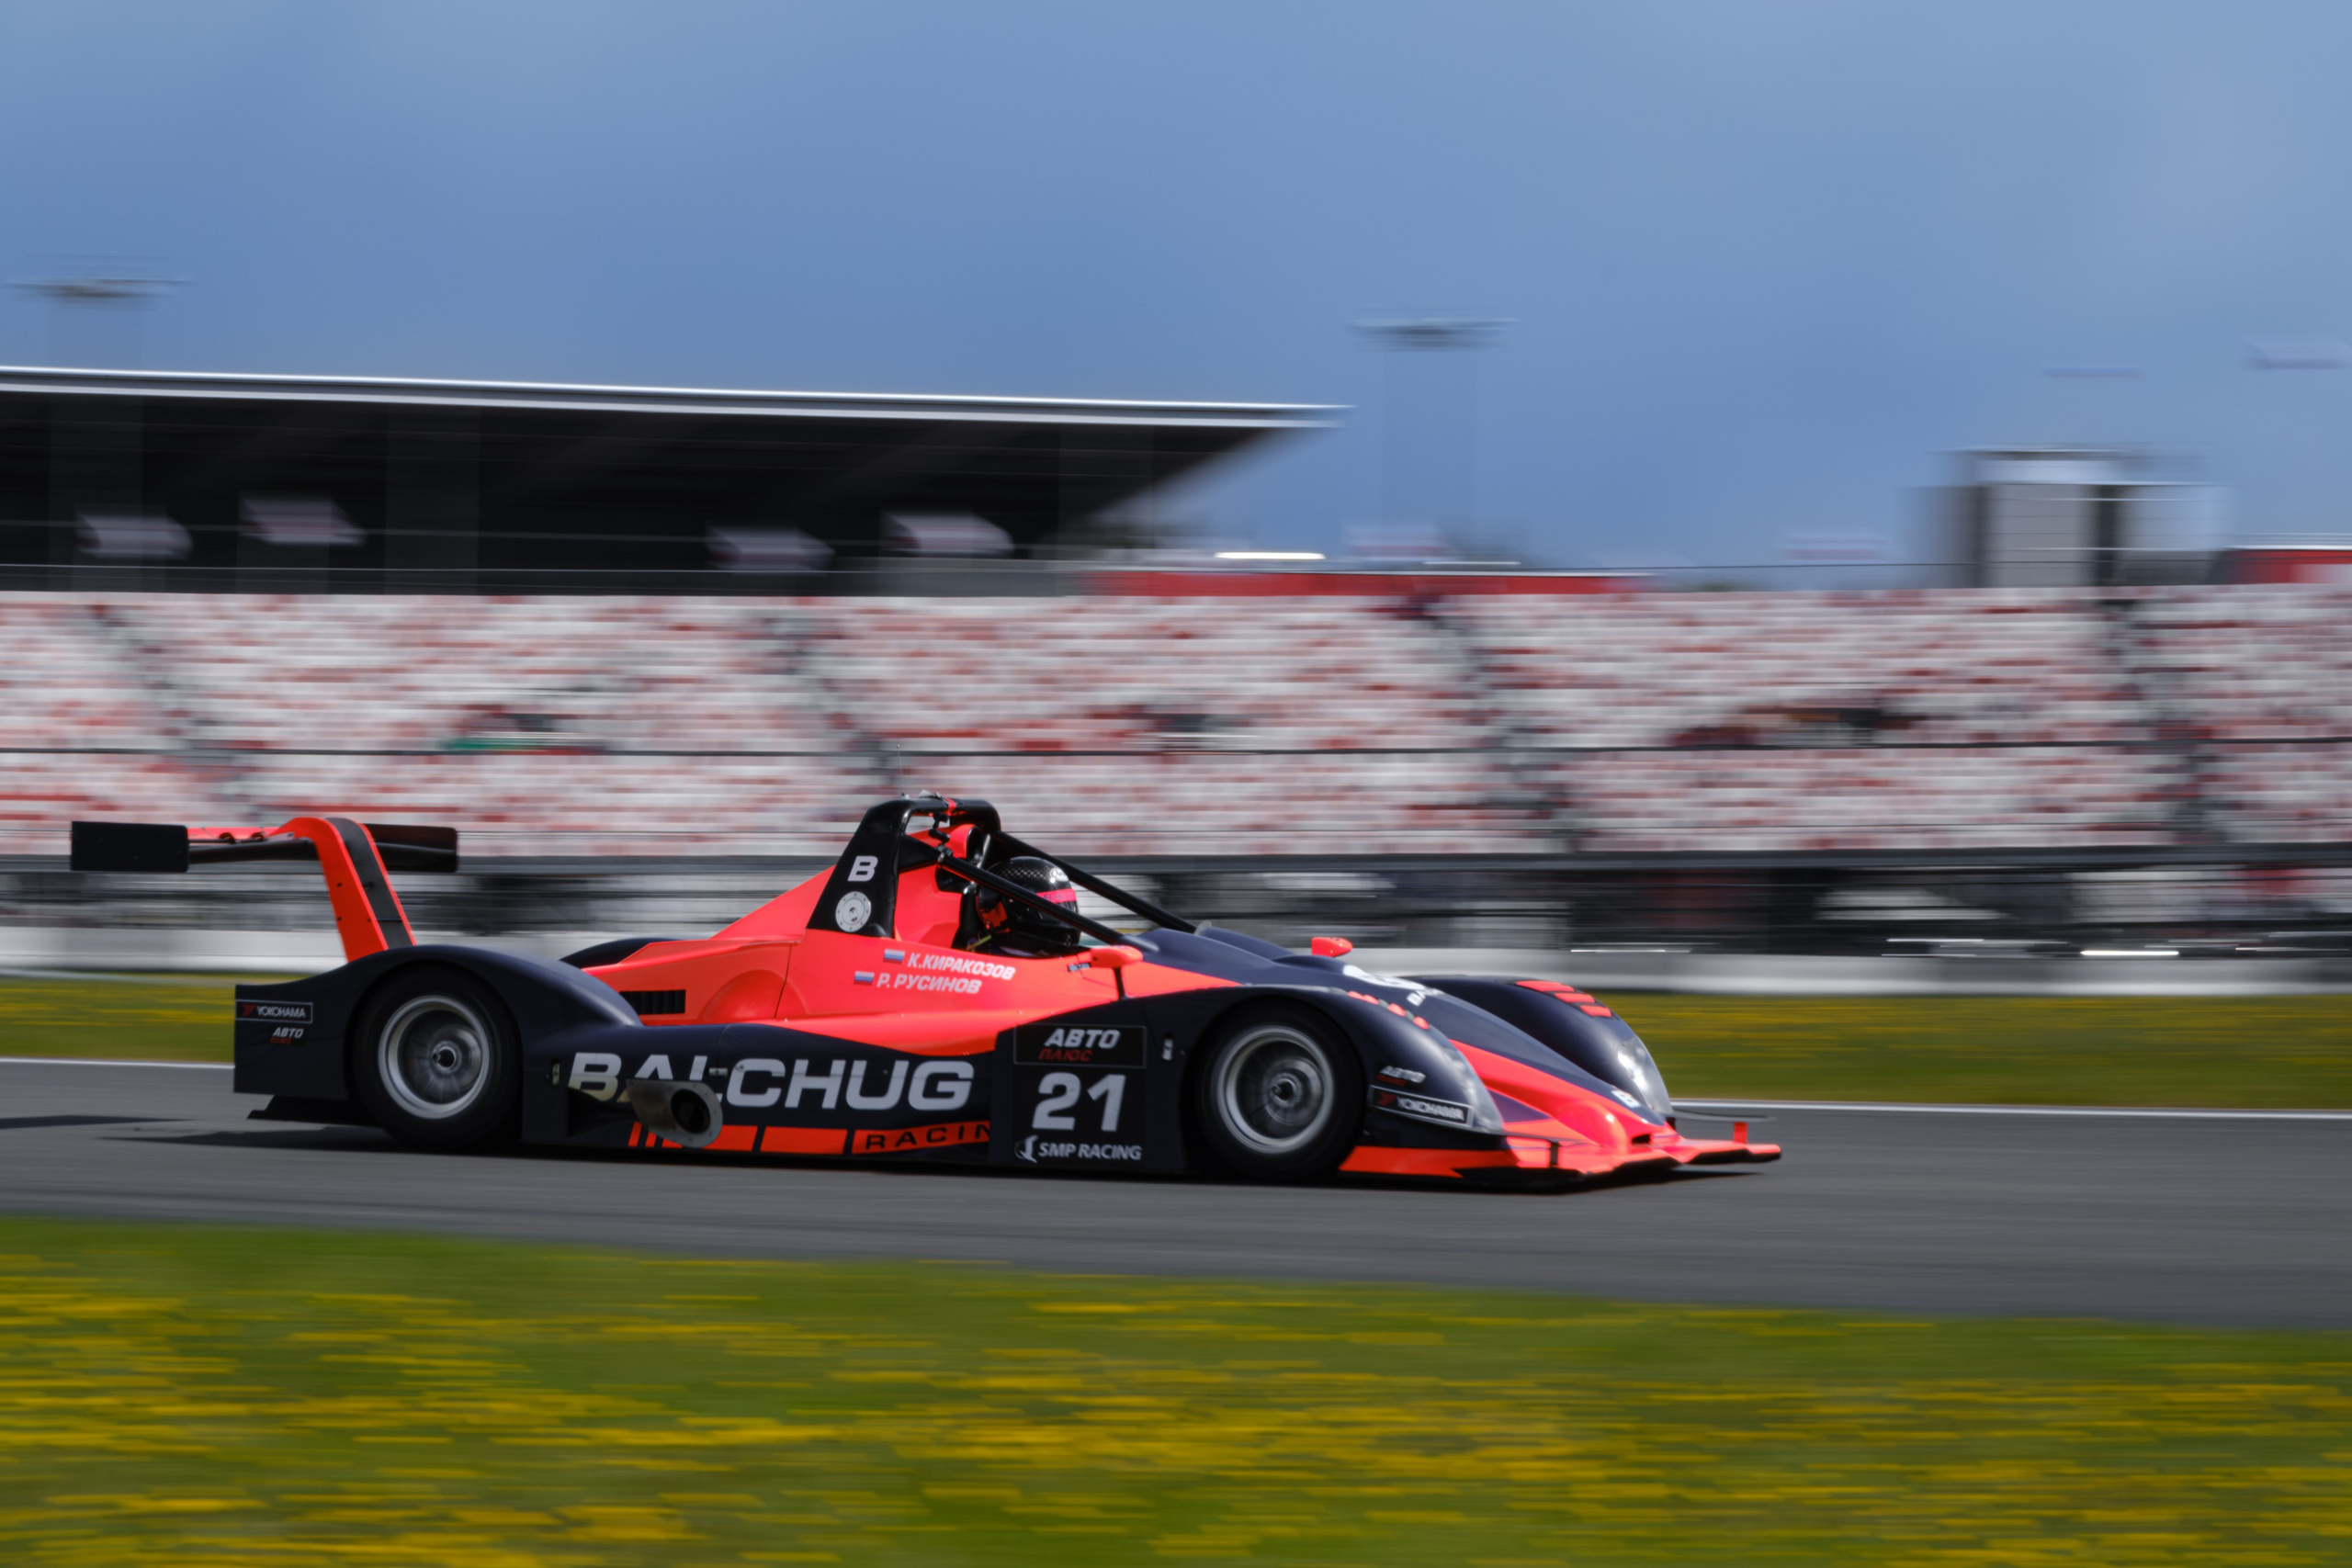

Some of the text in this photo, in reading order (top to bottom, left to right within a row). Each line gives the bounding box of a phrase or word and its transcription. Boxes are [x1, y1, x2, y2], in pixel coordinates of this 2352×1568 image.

[847, 855, 878, 882] B
[908, 953, 1016, 981] К.КИРАКОЗОВ
[894, 974, 982, 995] РУСИНОВ
[257, 1005, 307, 1019] YOKOHAMA
[1044, 1028, 1121, 1050] АВТО
[1038, 1048, 1093, 1063] ПЛЮС
[1032, 1072, 1126, 1132] 21
[1038, 1142, 1143, 1160] SMP RACING
